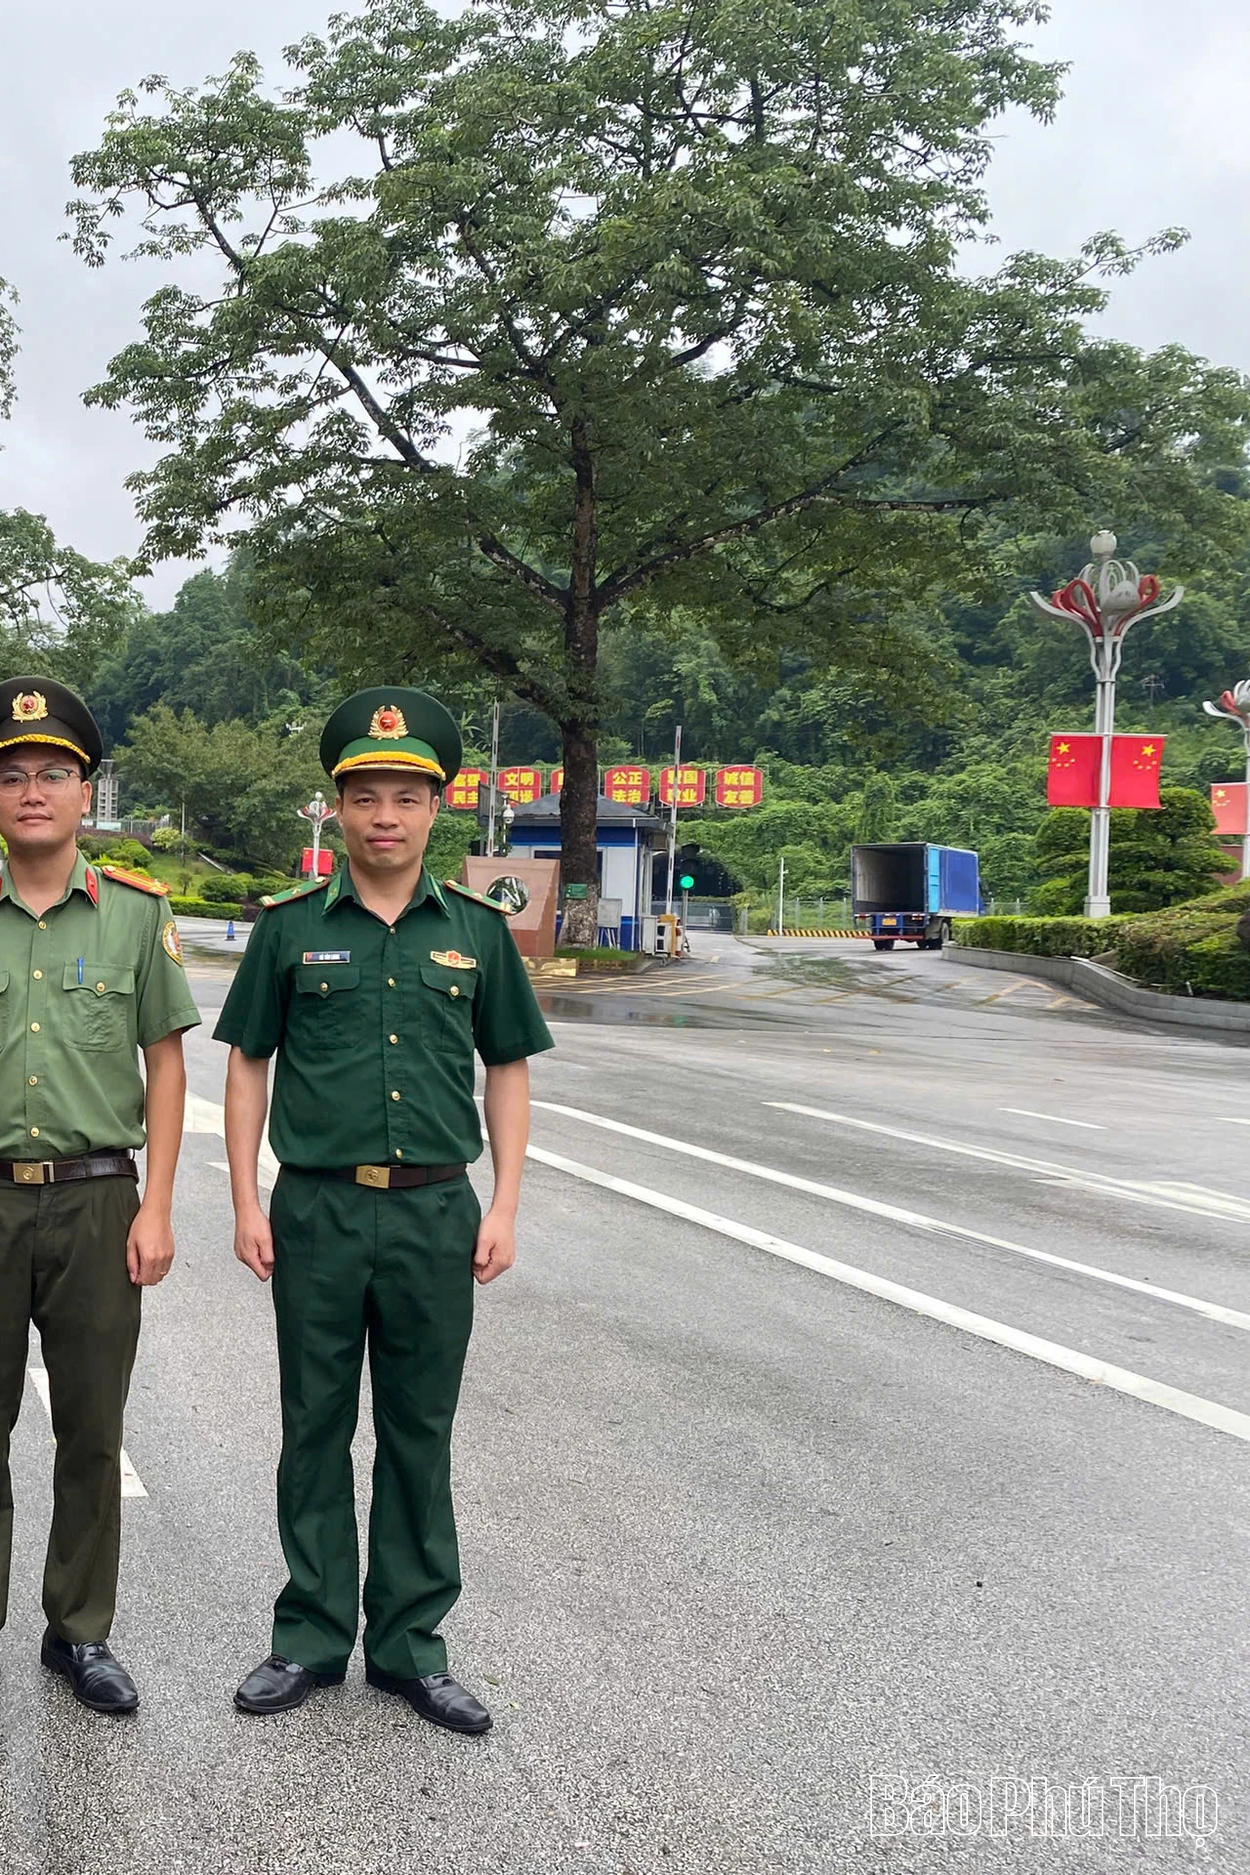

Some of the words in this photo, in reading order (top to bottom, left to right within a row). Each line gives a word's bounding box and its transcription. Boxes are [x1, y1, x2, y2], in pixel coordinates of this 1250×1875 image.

[505, 772, 534, 786] 文明
[613, 771, 643, 785] 公正
[724, 772, 755, 786] 诚信
[453, 791, 478, 804] 民主
[612, 789, 641, 803] 法治
[723, 790, 754, 804] 友善
